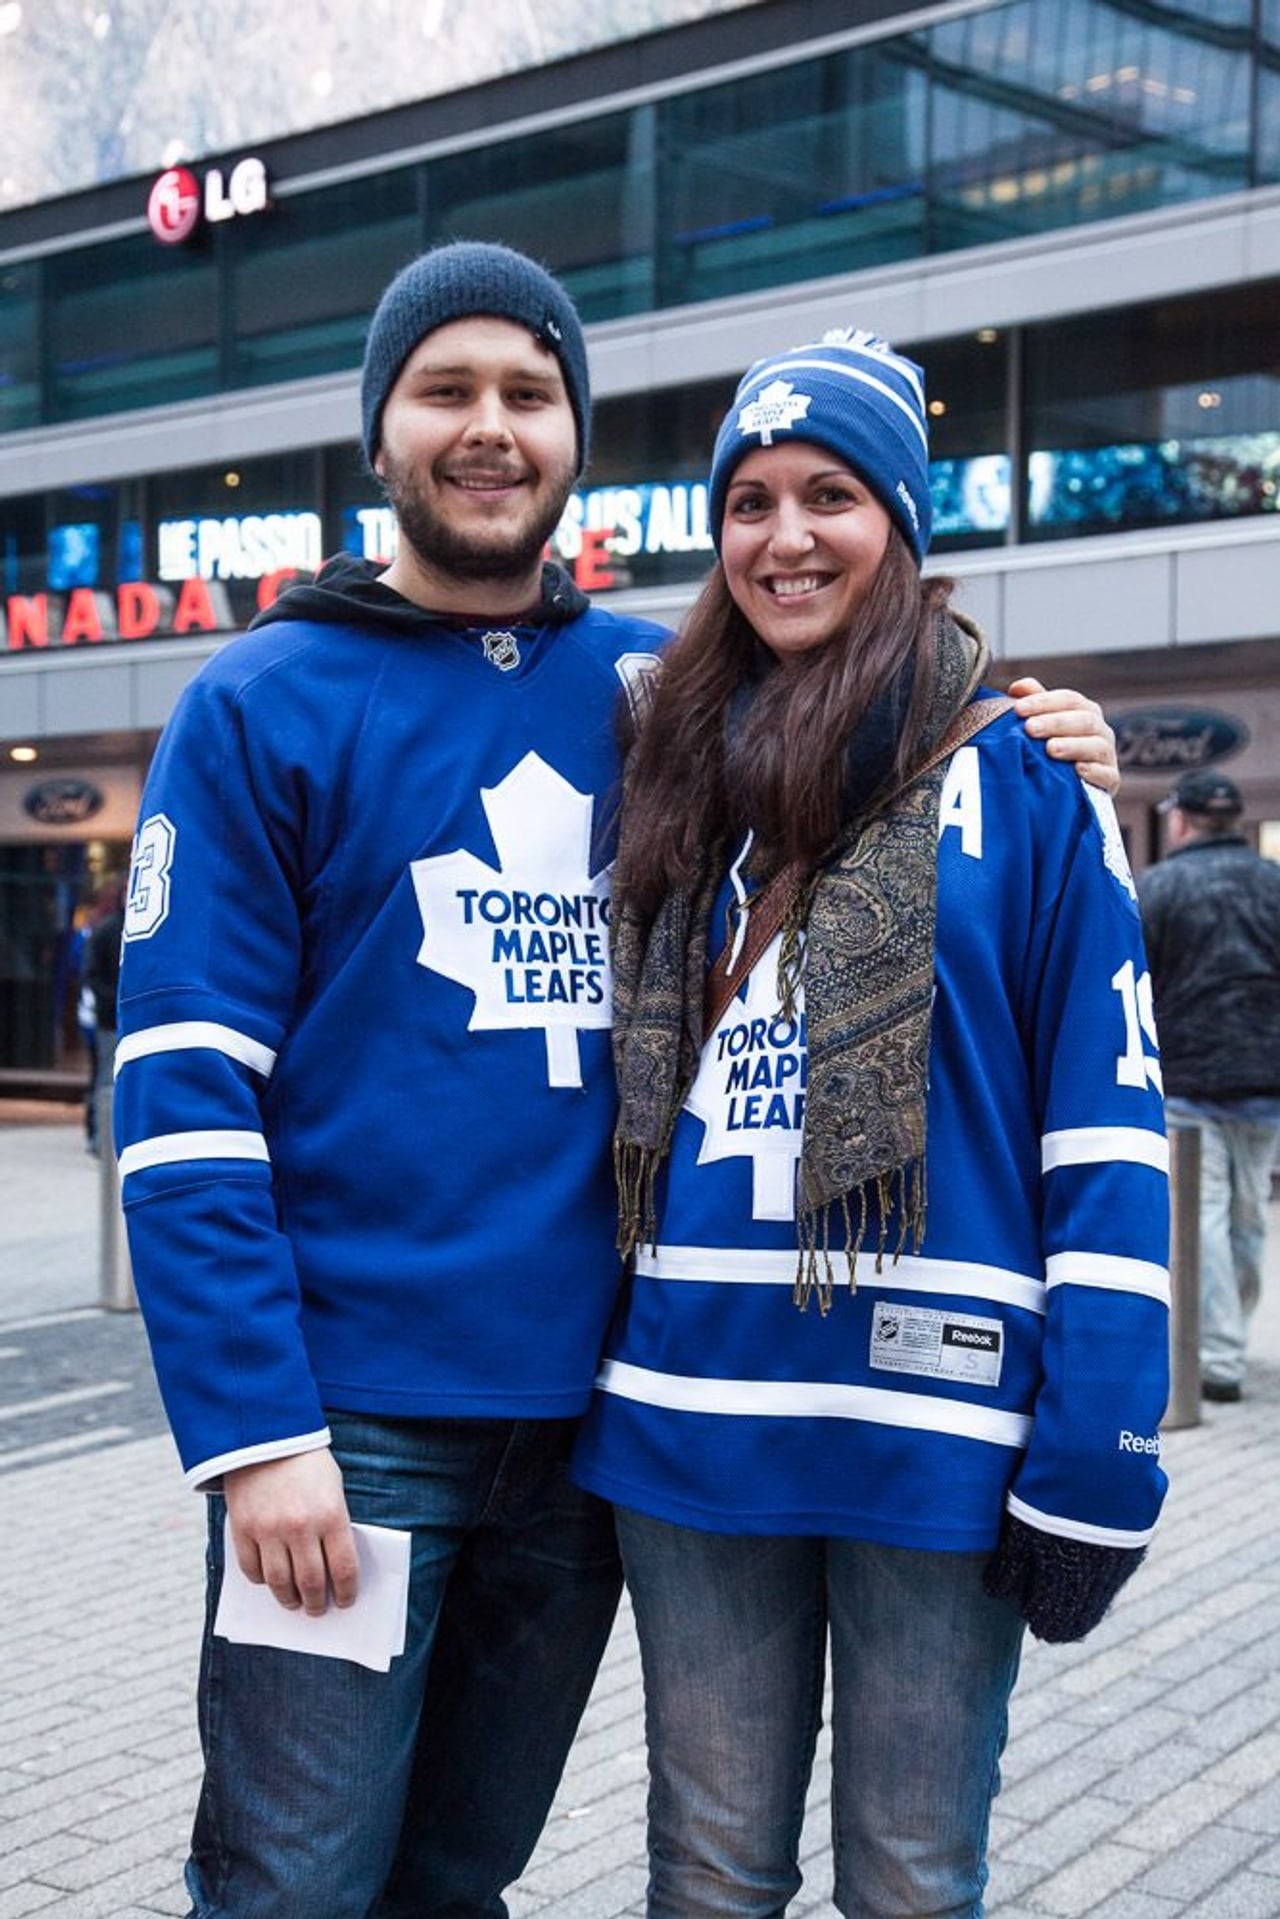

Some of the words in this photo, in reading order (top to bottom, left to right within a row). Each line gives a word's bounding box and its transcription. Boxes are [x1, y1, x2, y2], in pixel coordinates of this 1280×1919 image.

[204, 157, 267, 222] LG
[938, 746, 983, 860] A
[492, 928, 606, 966] MAPLE
[505, 968, 604, 1005] LEAFS
[952, 1329, 992, 1347] Reebok
